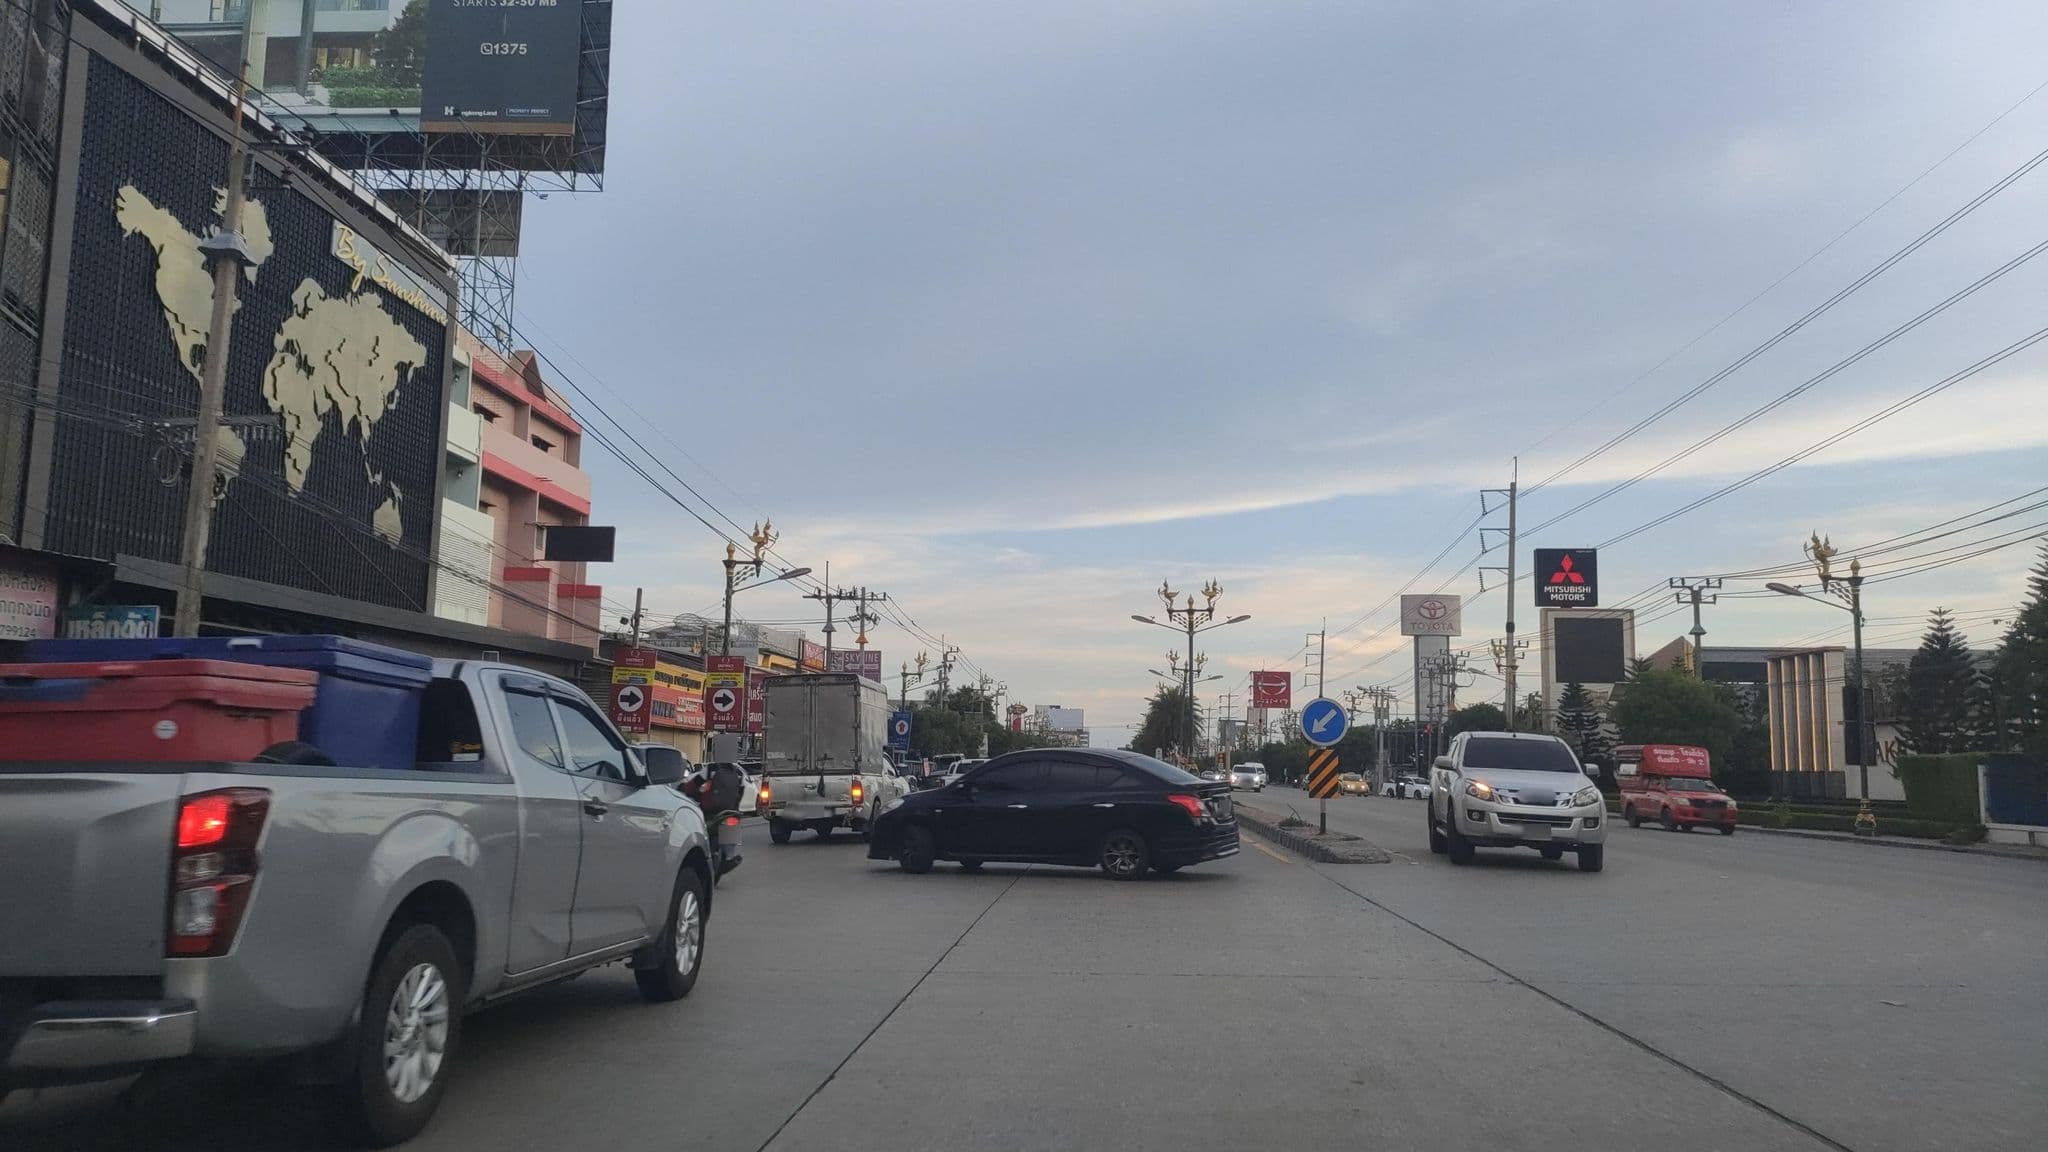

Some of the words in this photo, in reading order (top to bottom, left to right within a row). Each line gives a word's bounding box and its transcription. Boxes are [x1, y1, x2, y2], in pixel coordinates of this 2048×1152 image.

[494, 43, 527, 55] 1375
[335, 226, 366, 292] By
[1544, 585, 1592, 594] MITSUBISHI
[1550, 593, 1586, 601] MOTORS
[1410, 622, 1455, 632] TOYOTA
[844, 653, 880, 663] SKYINE
